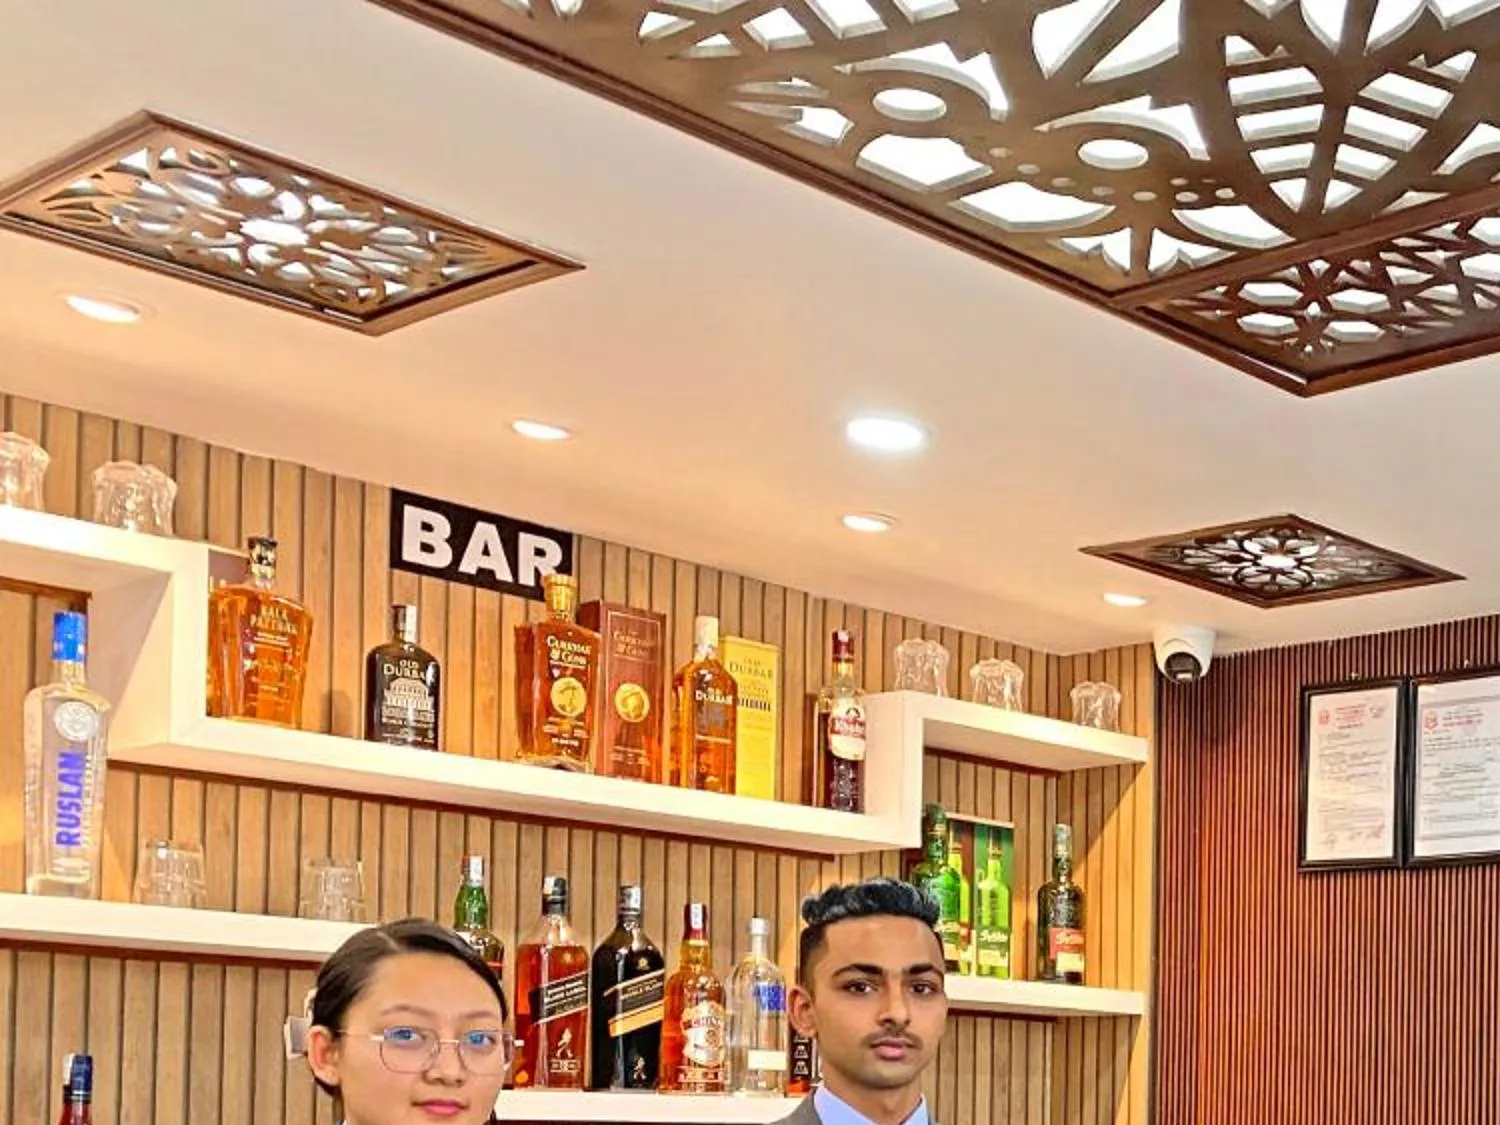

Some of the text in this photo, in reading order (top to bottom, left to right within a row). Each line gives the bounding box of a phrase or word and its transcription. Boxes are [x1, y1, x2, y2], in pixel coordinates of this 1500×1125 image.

[402, 504, 563, 587] BAR
[383, 663, 426, 679] DURBA
[55, 752, 86, 846] RUSLAN
